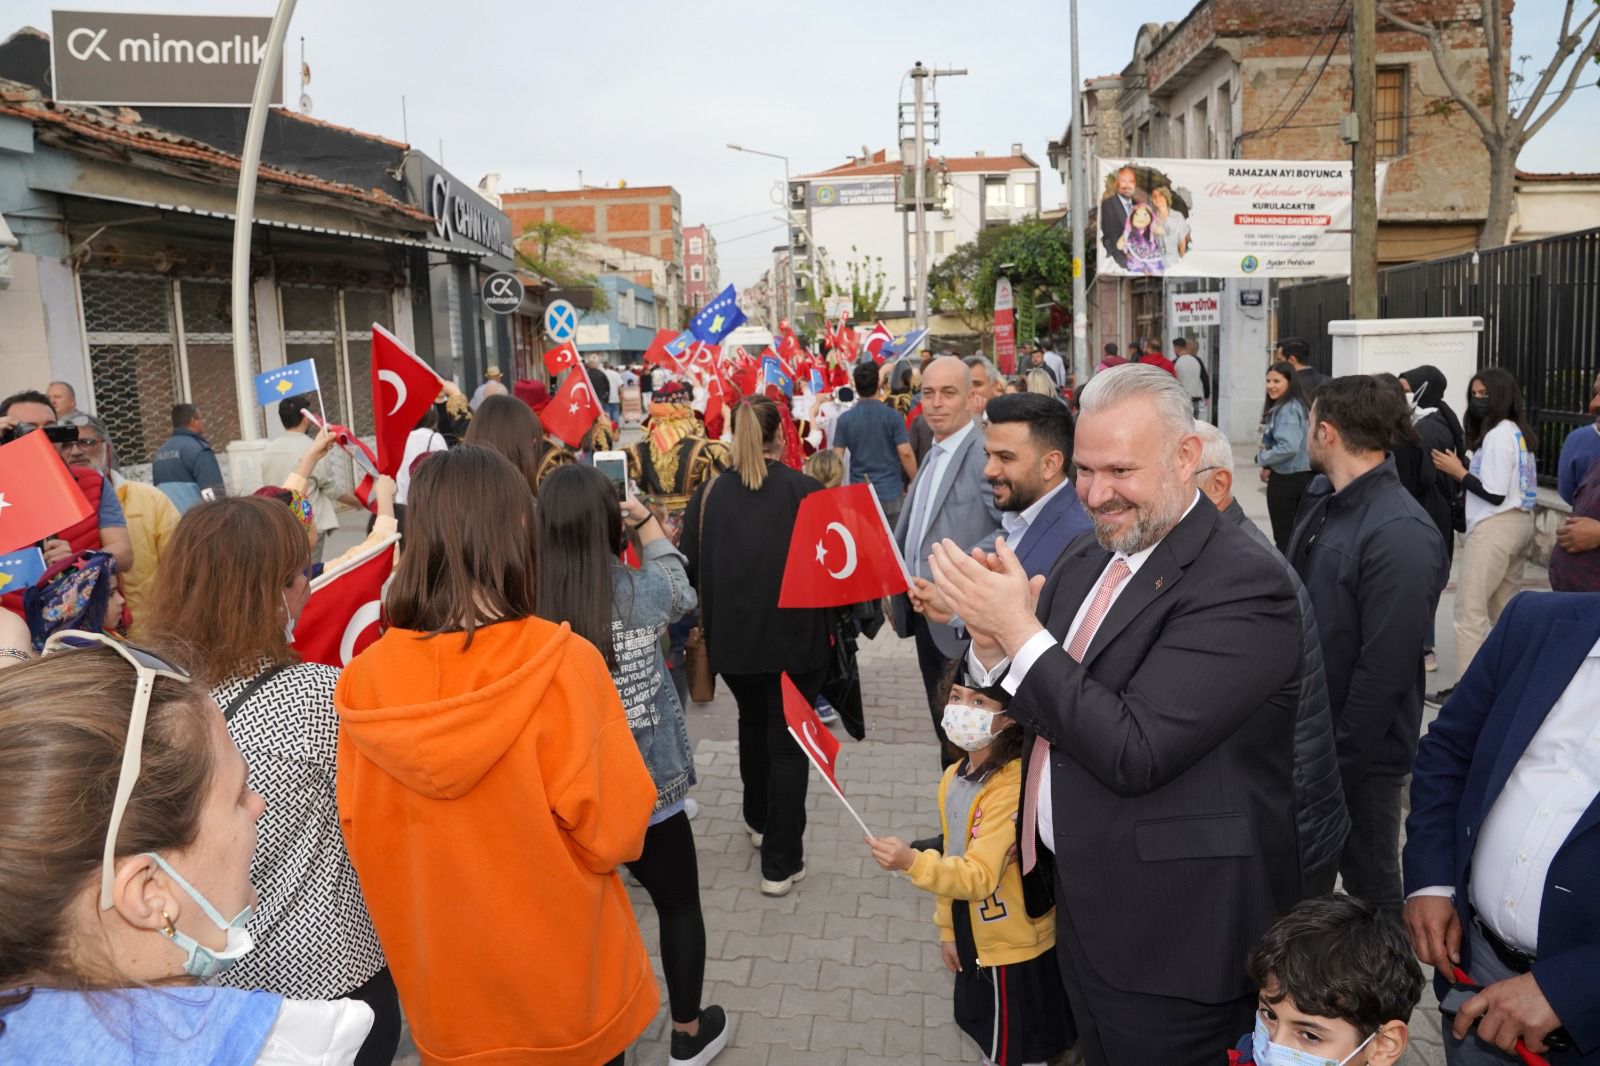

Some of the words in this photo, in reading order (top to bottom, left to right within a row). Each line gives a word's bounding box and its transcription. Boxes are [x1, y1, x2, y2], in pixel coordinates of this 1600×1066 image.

[119, 32, 268, 64] mimarlık
[1228, 168, 1278, 177] RAMAZAN
[1279, 169, 1295, 177] AYI
[1296, 169, 1343, 178] BOYUNCA
[1238, 215, 1254, 224] TÜM
[1174, 301, 1193, 314] TUNÇ
[1194, 297, 1217, 312] TÜTÜN
[616, 629, 635, 641] FREE
